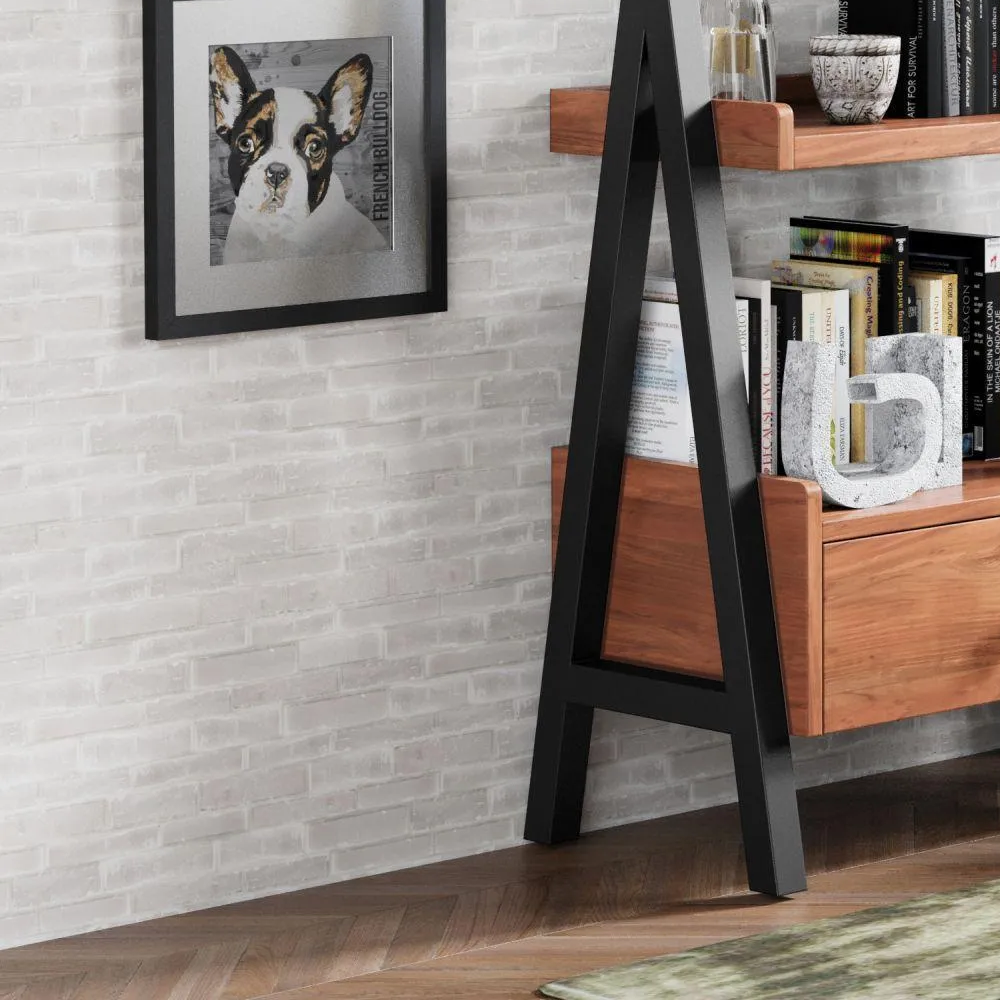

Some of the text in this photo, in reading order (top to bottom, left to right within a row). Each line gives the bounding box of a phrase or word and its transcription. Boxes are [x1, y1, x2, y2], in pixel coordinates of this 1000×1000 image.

[838, 0, 849, 36] SURVIVA
[907, 36, 917, 118] ART FOR SURVIVAL
[373, 90, 388, 221] FRENCH BULLDOG
[865, 276, 874, 339] Creating Magi
[986, 301, 994, 323] LION
[986, 334, 994, 347] OF
[838, 350, 846, 366] Elijah
[986, 348, 994, 371] SKIN
[986, 374, 994, 392] THE
[986, 394, 994, 403] IN
[762, 410, 773, 466] BECAUSE
